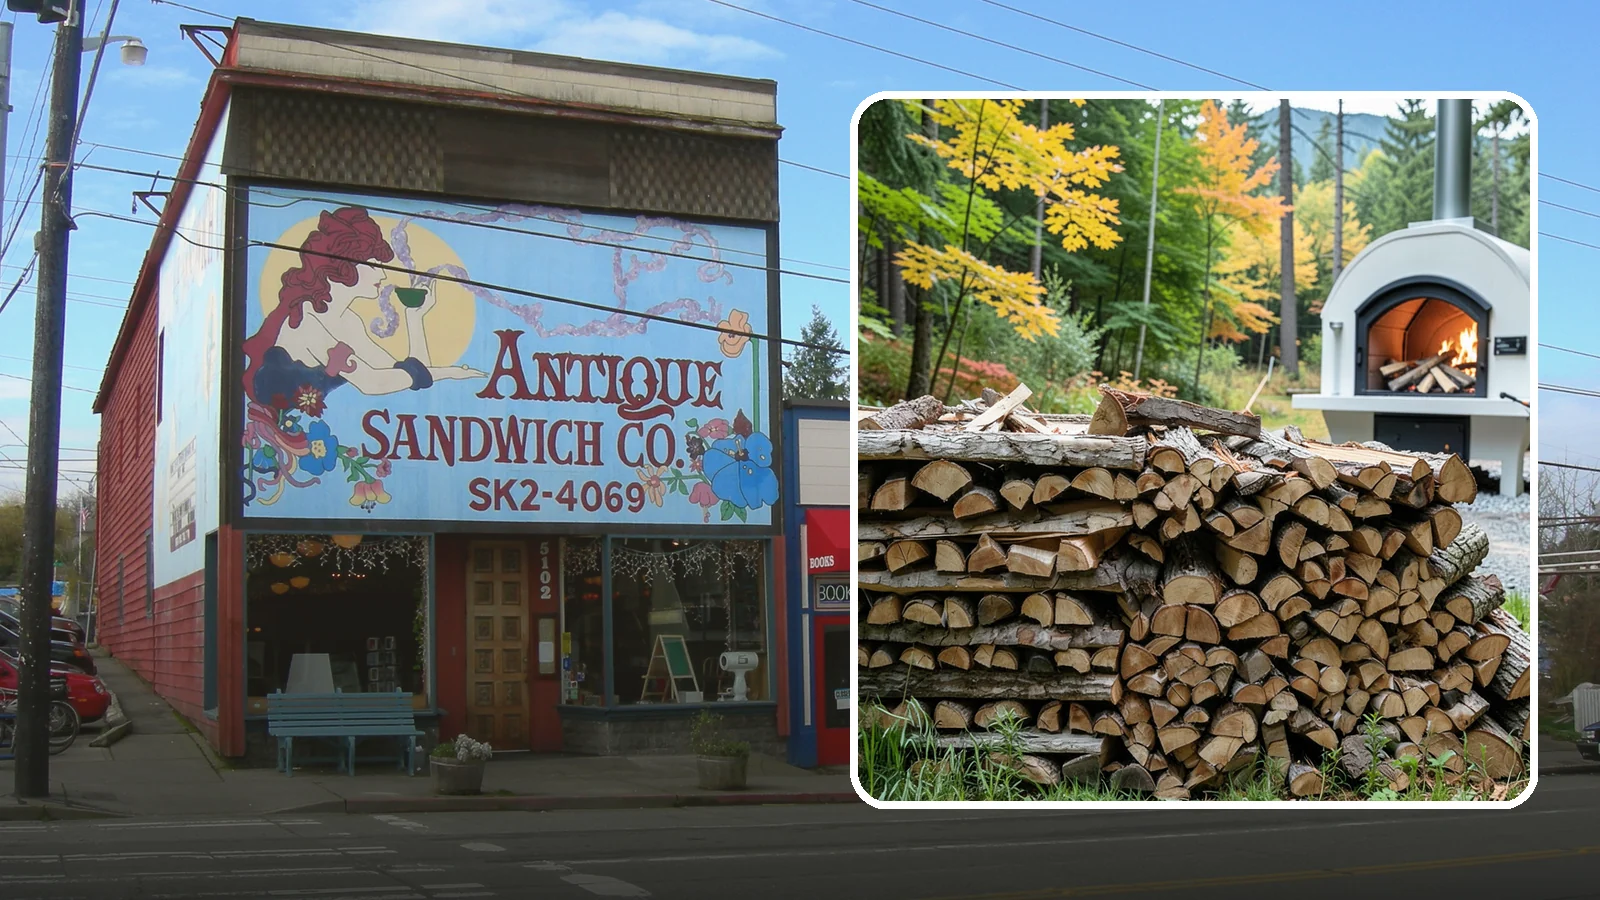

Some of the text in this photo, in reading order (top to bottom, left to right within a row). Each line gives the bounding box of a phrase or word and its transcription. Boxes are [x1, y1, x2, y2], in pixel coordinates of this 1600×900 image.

[476, 329, 724, 420] ANTIQUE
[362, 409, 684, 468] SANDWICH CO.
[469, 476, 645, 513] SK2-4069
[539, 542, 551, 600] 5102
[809, 555, 835, 569] BOOKS
